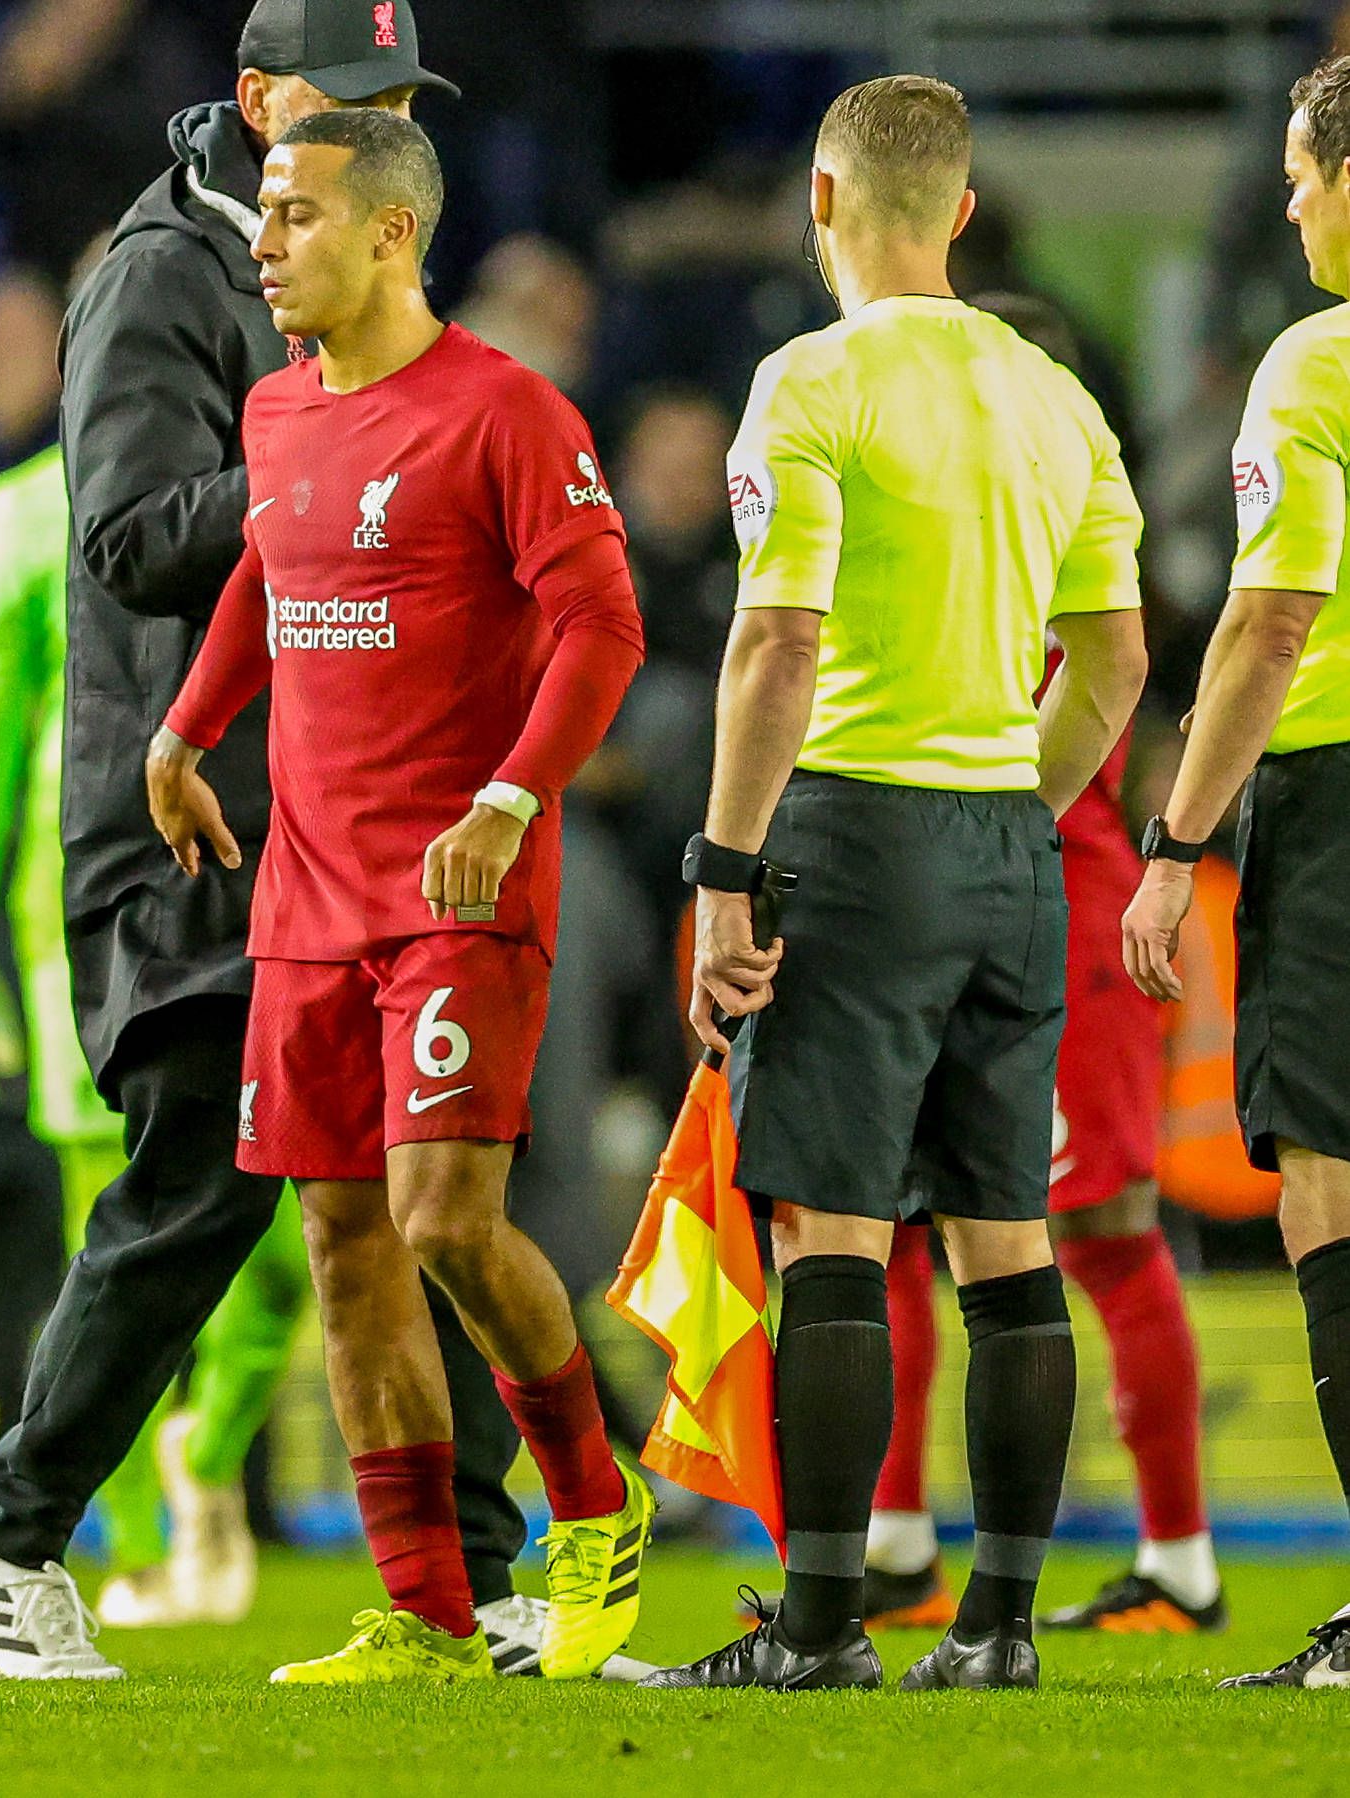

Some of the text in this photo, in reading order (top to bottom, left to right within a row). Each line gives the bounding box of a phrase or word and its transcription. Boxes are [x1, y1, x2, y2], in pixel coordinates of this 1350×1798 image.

[729, 473, 763, 507] EA
[1229, 460, 1269, 491] EA
[1234, 490, 1270, 507] PORTS
[278, 595, 388, 624] standard
[279, 621, 396, 650] chartered
[413, 986, 471, 1078] 6
